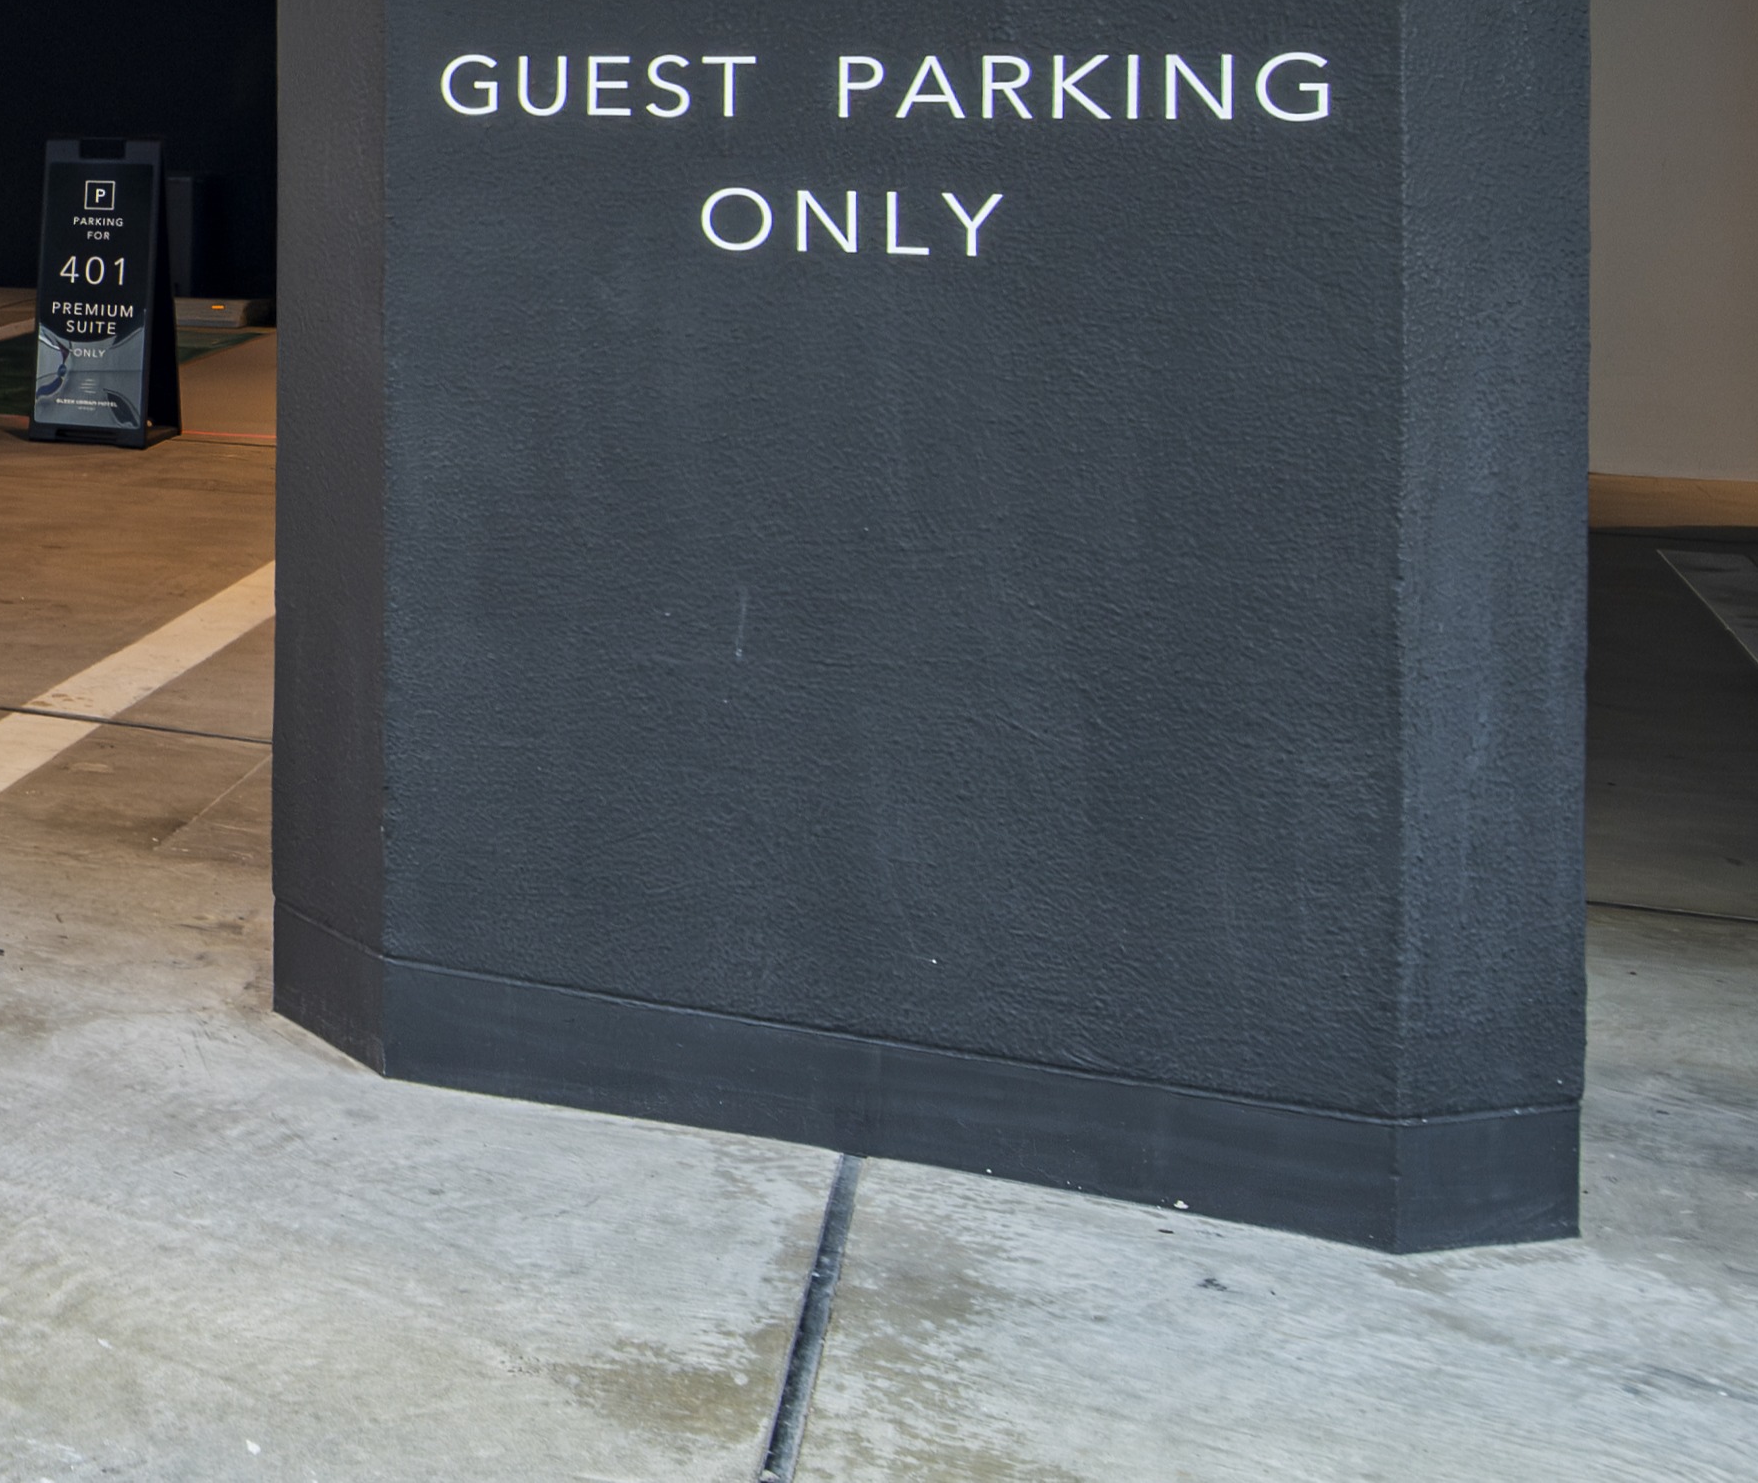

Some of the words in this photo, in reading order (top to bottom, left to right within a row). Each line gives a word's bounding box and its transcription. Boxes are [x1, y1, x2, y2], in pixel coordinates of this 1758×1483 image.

[440, 54, 758, 118] GUEST
[838, 51, 1332, 123] PARKING
[95, 188, 106, 204] P
[72, 216, 125, 228] PARKING
[699, 187, 1005, 257] ONLY
[86, 230, 111, 241] FOR
[59, 255, 126, 286] 401
[51, 301, 135, 318] PREMIUM
[66, 319, 118, 335] SUITE
[73, 347, 107, 359] ONLY
